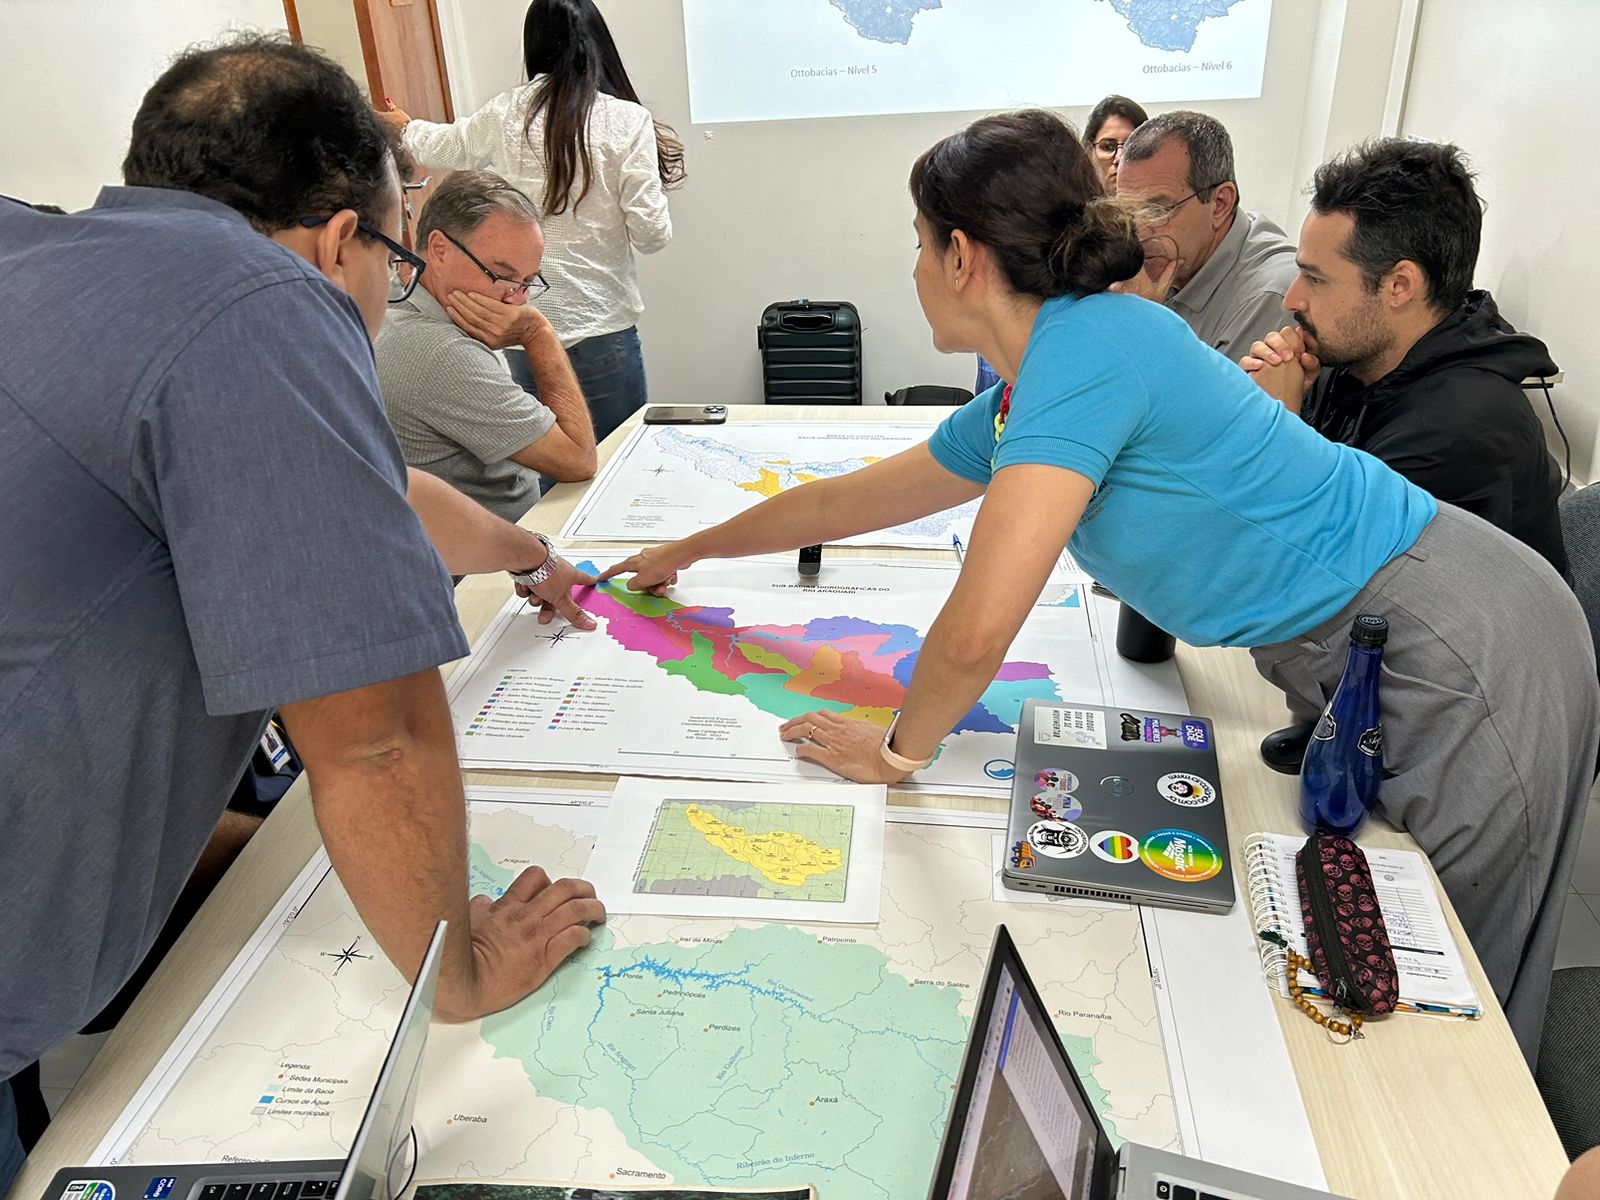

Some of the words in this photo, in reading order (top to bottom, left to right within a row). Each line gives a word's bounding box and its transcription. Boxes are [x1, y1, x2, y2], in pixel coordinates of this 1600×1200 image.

[790, 66, 838, 78] Ottobacias
[871, 64, 877, 74] 5
[1142, 62, 1191, 74] Ottobacias
[1226, 61, 1233, 70] 6
[1173, 837, 1188, 872] Mosaic
[636, 1008, 662, 1016] Santa
[1058, 1009, 1071, 1017] Rio
[709, 1023, 741, 1032] Perdizes
[289, 1074, 310, 1083] Sedes
[305, 1086, 314, 1094] da
[314, 1087, 334, 1095] Bacia
[275, 1097, 297, 1105] Cursos
[453, 1113, 488, 1123] Uberaba
[736, 1158, 771, 1170] Ribeirão
[772, 1156, 784, 1164] do
[785, 1151, 815, 1162] Inferno
[616, 1167, 666, 1180] Sacramento
